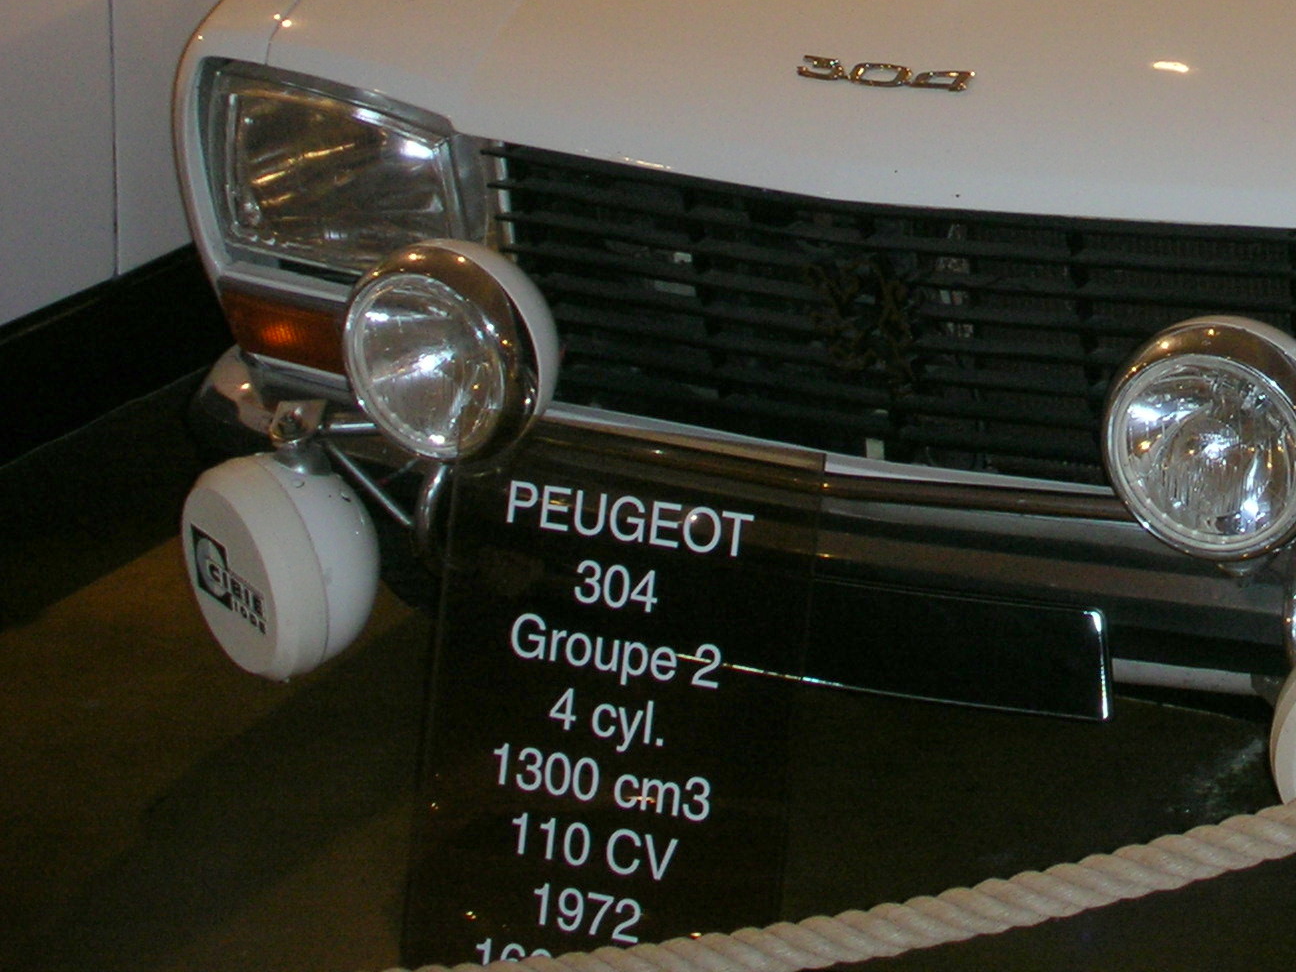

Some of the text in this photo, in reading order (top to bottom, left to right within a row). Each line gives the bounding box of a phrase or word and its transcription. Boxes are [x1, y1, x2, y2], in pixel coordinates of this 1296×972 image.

[796, 54, 976, 92] 304
[504, 480, 755, 558] PEUGEOT
[573, 559, 659, 613] 304
[510, 612, 722, 689] Groupe 2
[549, 687, 665, 753] 4 cyl.
[493, 742, 711, 822] 1300 cm3
[511, 811, 679, 881] 110 CV
[533, 882, 642, 944] 1972
